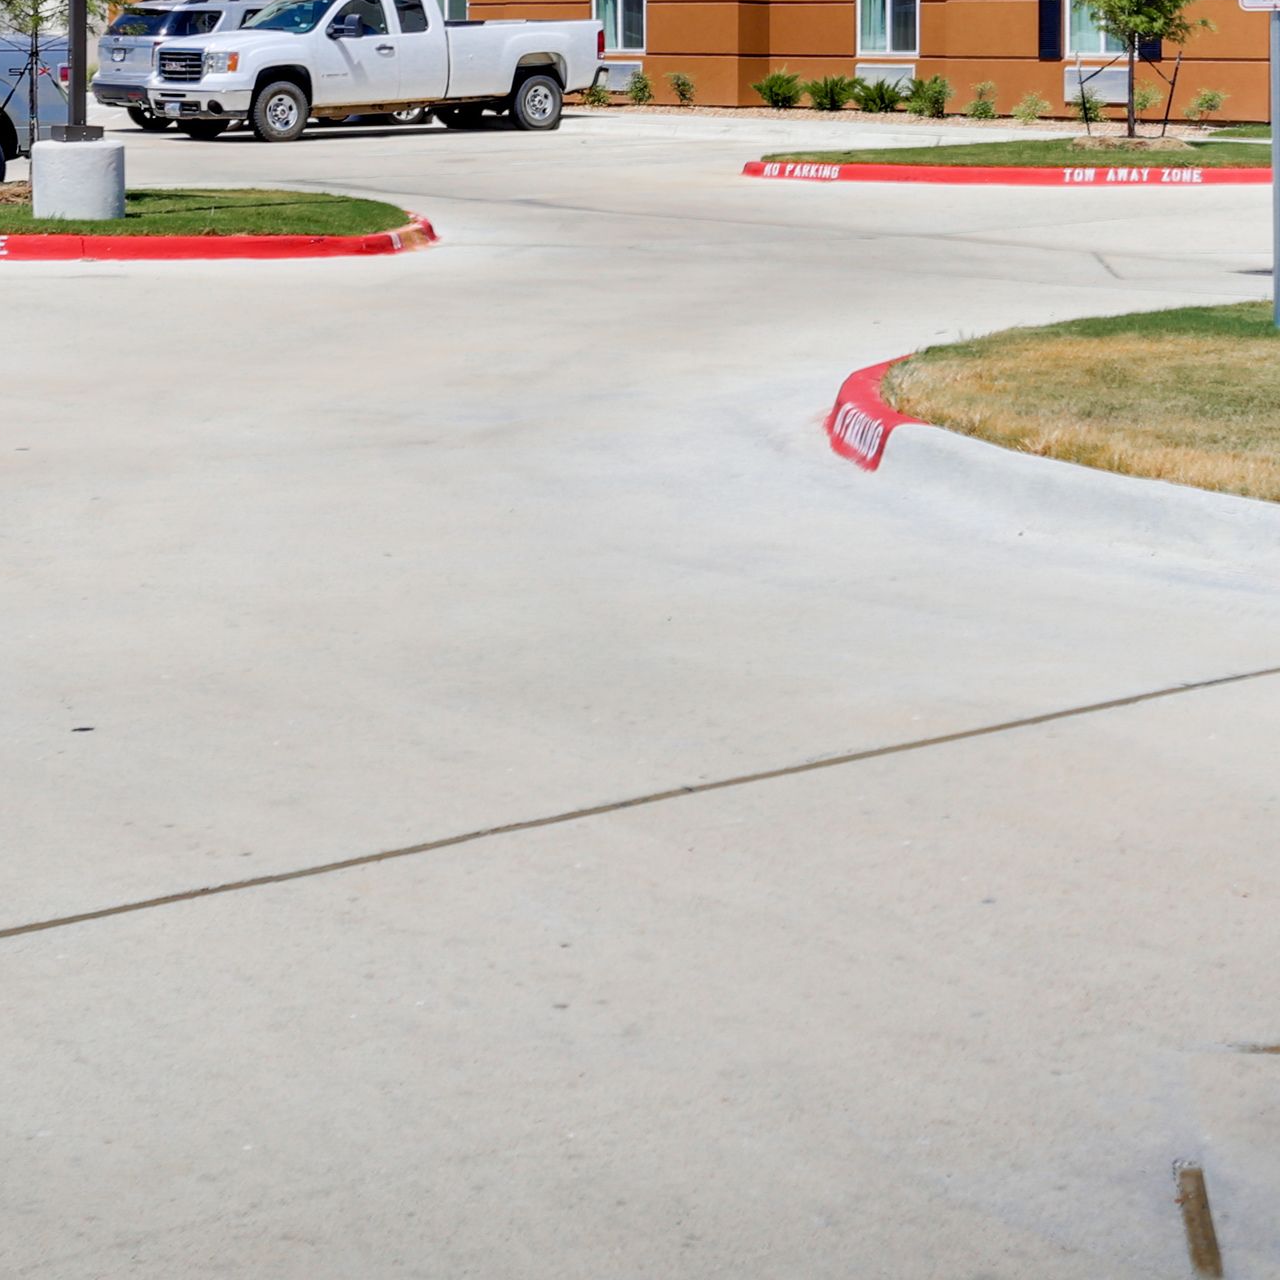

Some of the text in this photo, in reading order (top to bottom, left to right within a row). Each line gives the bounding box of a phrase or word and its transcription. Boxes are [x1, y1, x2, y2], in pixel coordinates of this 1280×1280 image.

[764, 163, 839, 178] NO PARKING
[1063, 168, 1203, 183] TOW AWAY ZONE
